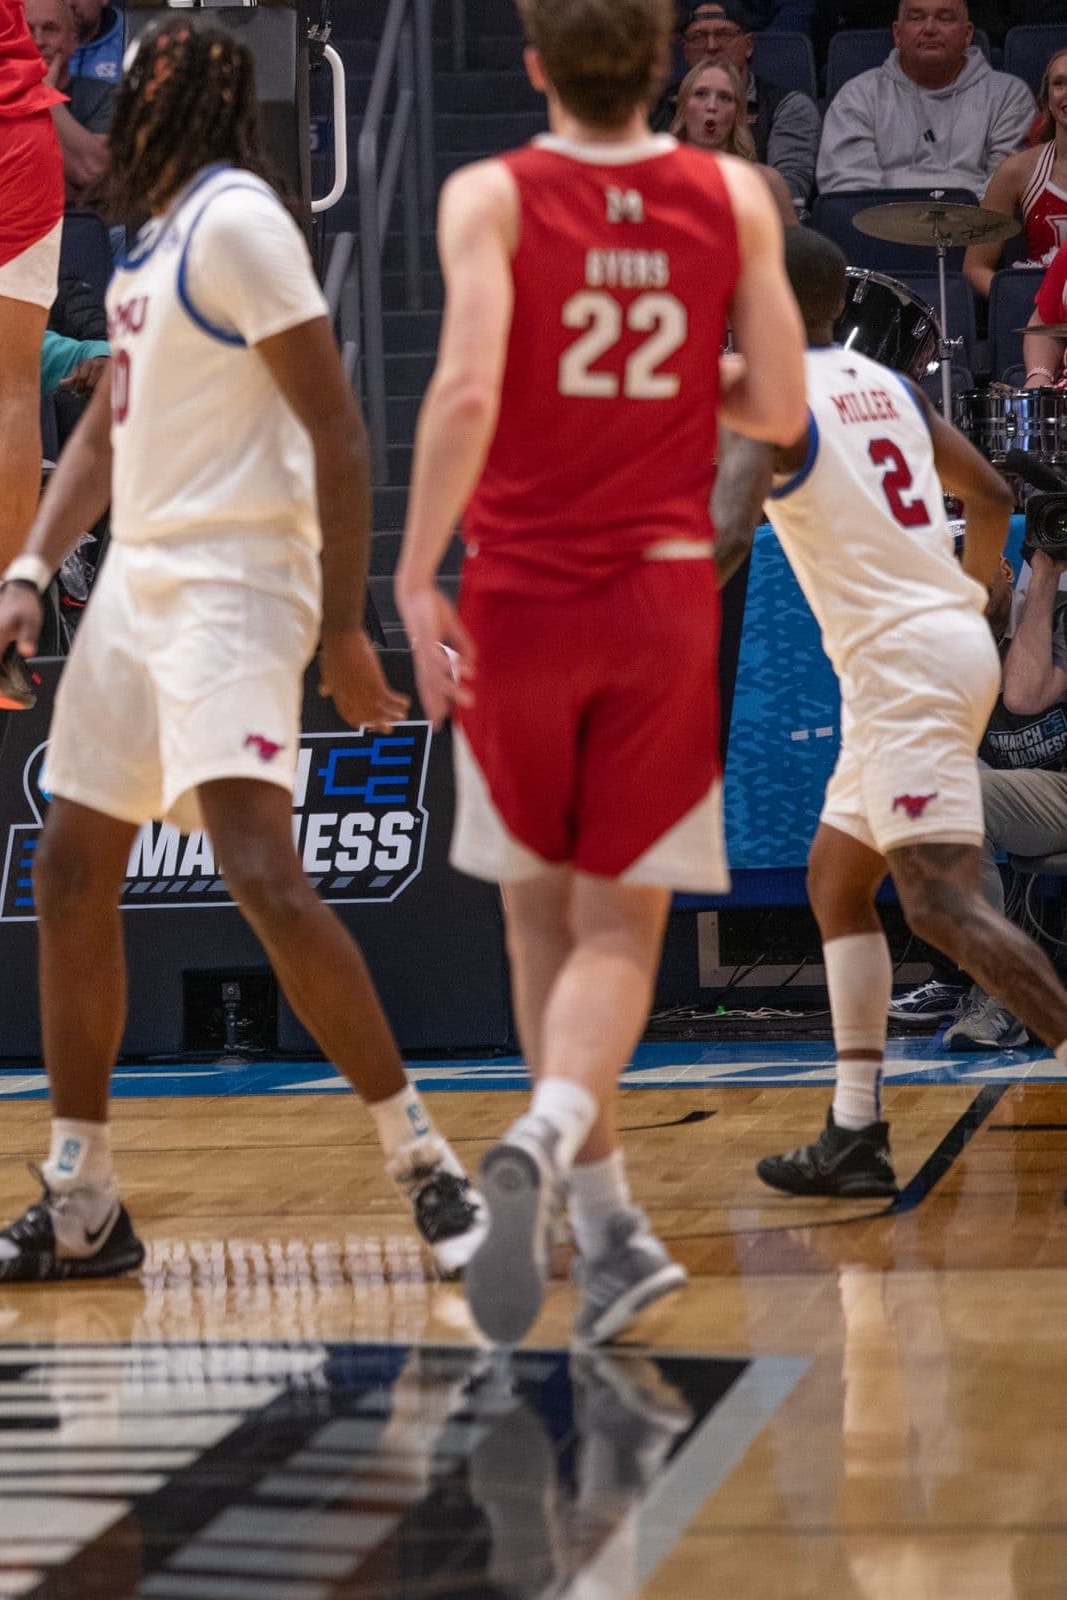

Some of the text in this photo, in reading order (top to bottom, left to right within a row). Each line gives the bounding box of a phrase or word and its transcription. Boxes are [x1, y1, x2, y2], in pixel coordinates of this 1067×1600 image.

[585, 248, 670, 289] BYERS
[557, 289, 688, 399] 22
[831, 389, 900, 425] MILLER
[868, 438, 932, 530] 2
[997, 725, 1044, 751] MARCH
[125, 812, 415, 877] MAESS
